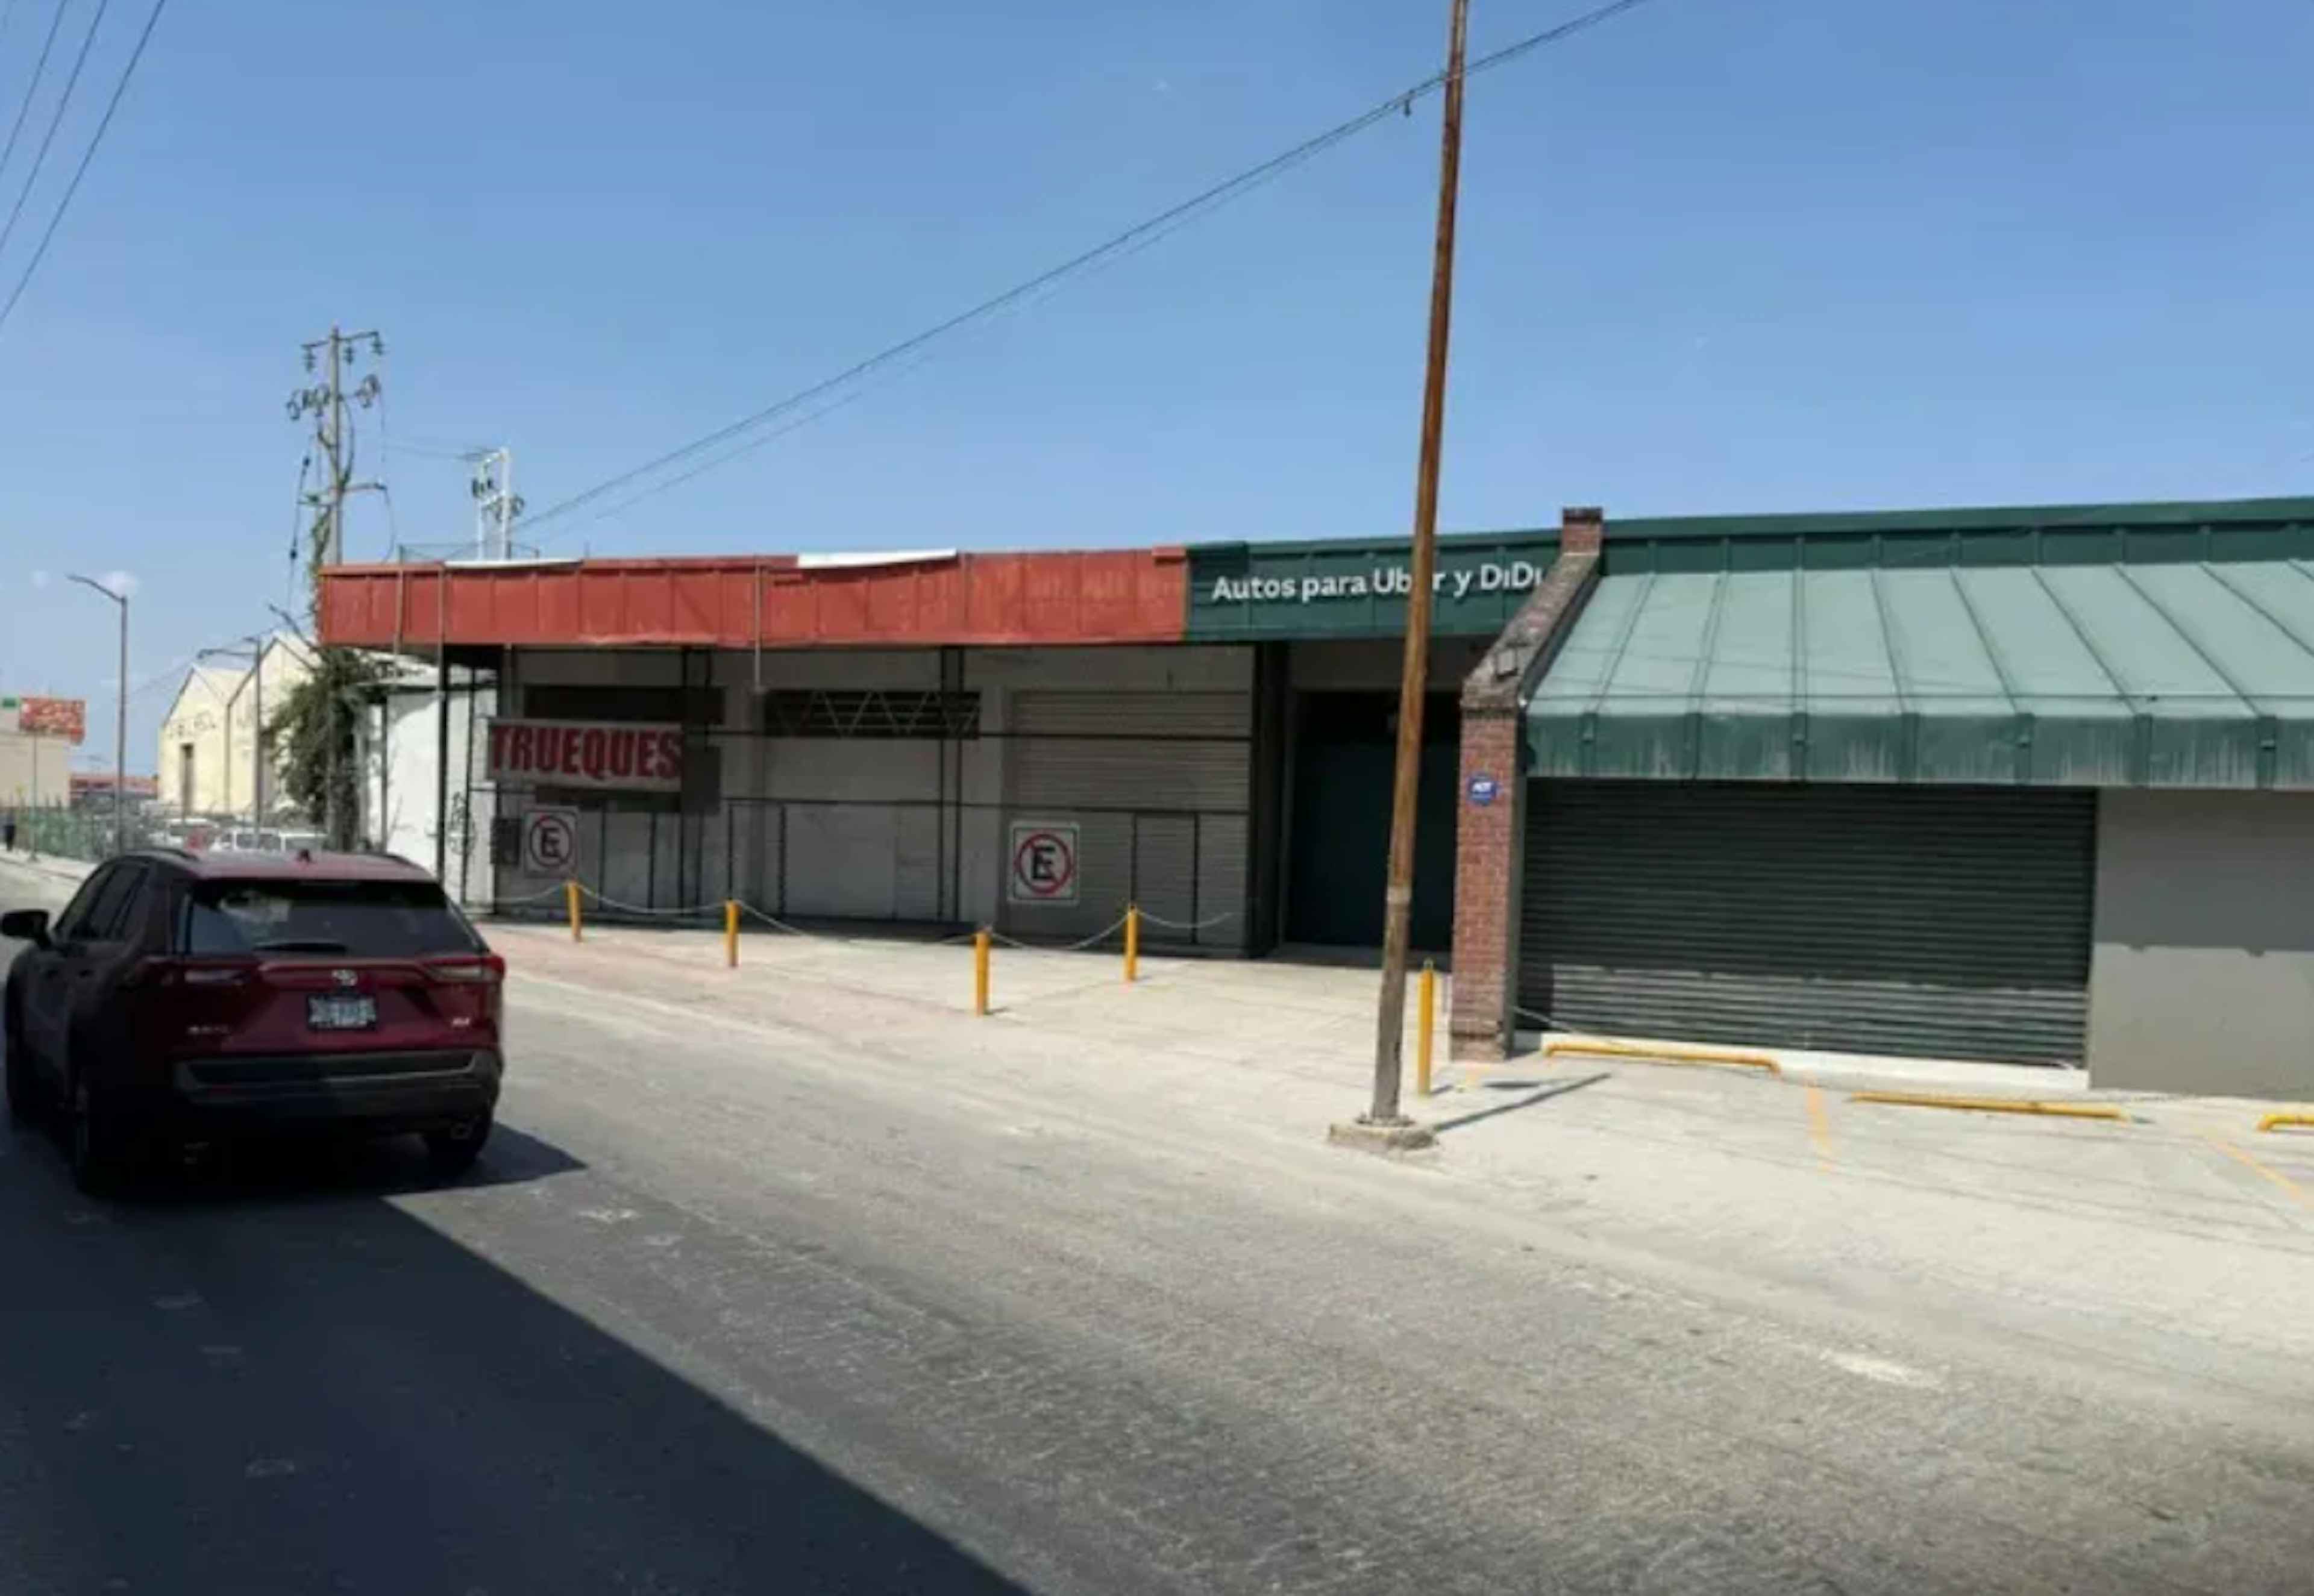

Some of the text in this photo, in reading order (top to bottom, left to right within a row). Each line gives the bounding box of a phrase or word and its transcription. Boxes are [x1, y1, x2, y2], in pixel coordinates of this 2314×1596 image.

[1211, 575, 1296, 600] Autos
[1301, 575, 1367, 603] para
[1373, 567, 1446, 593] Ubr
[1453, 570, 1473, 598] y
[491, 725, 683, 780] TRUEQUES
[541, 827, 560, 858] E
[1031, 845, 1056, 880] E
